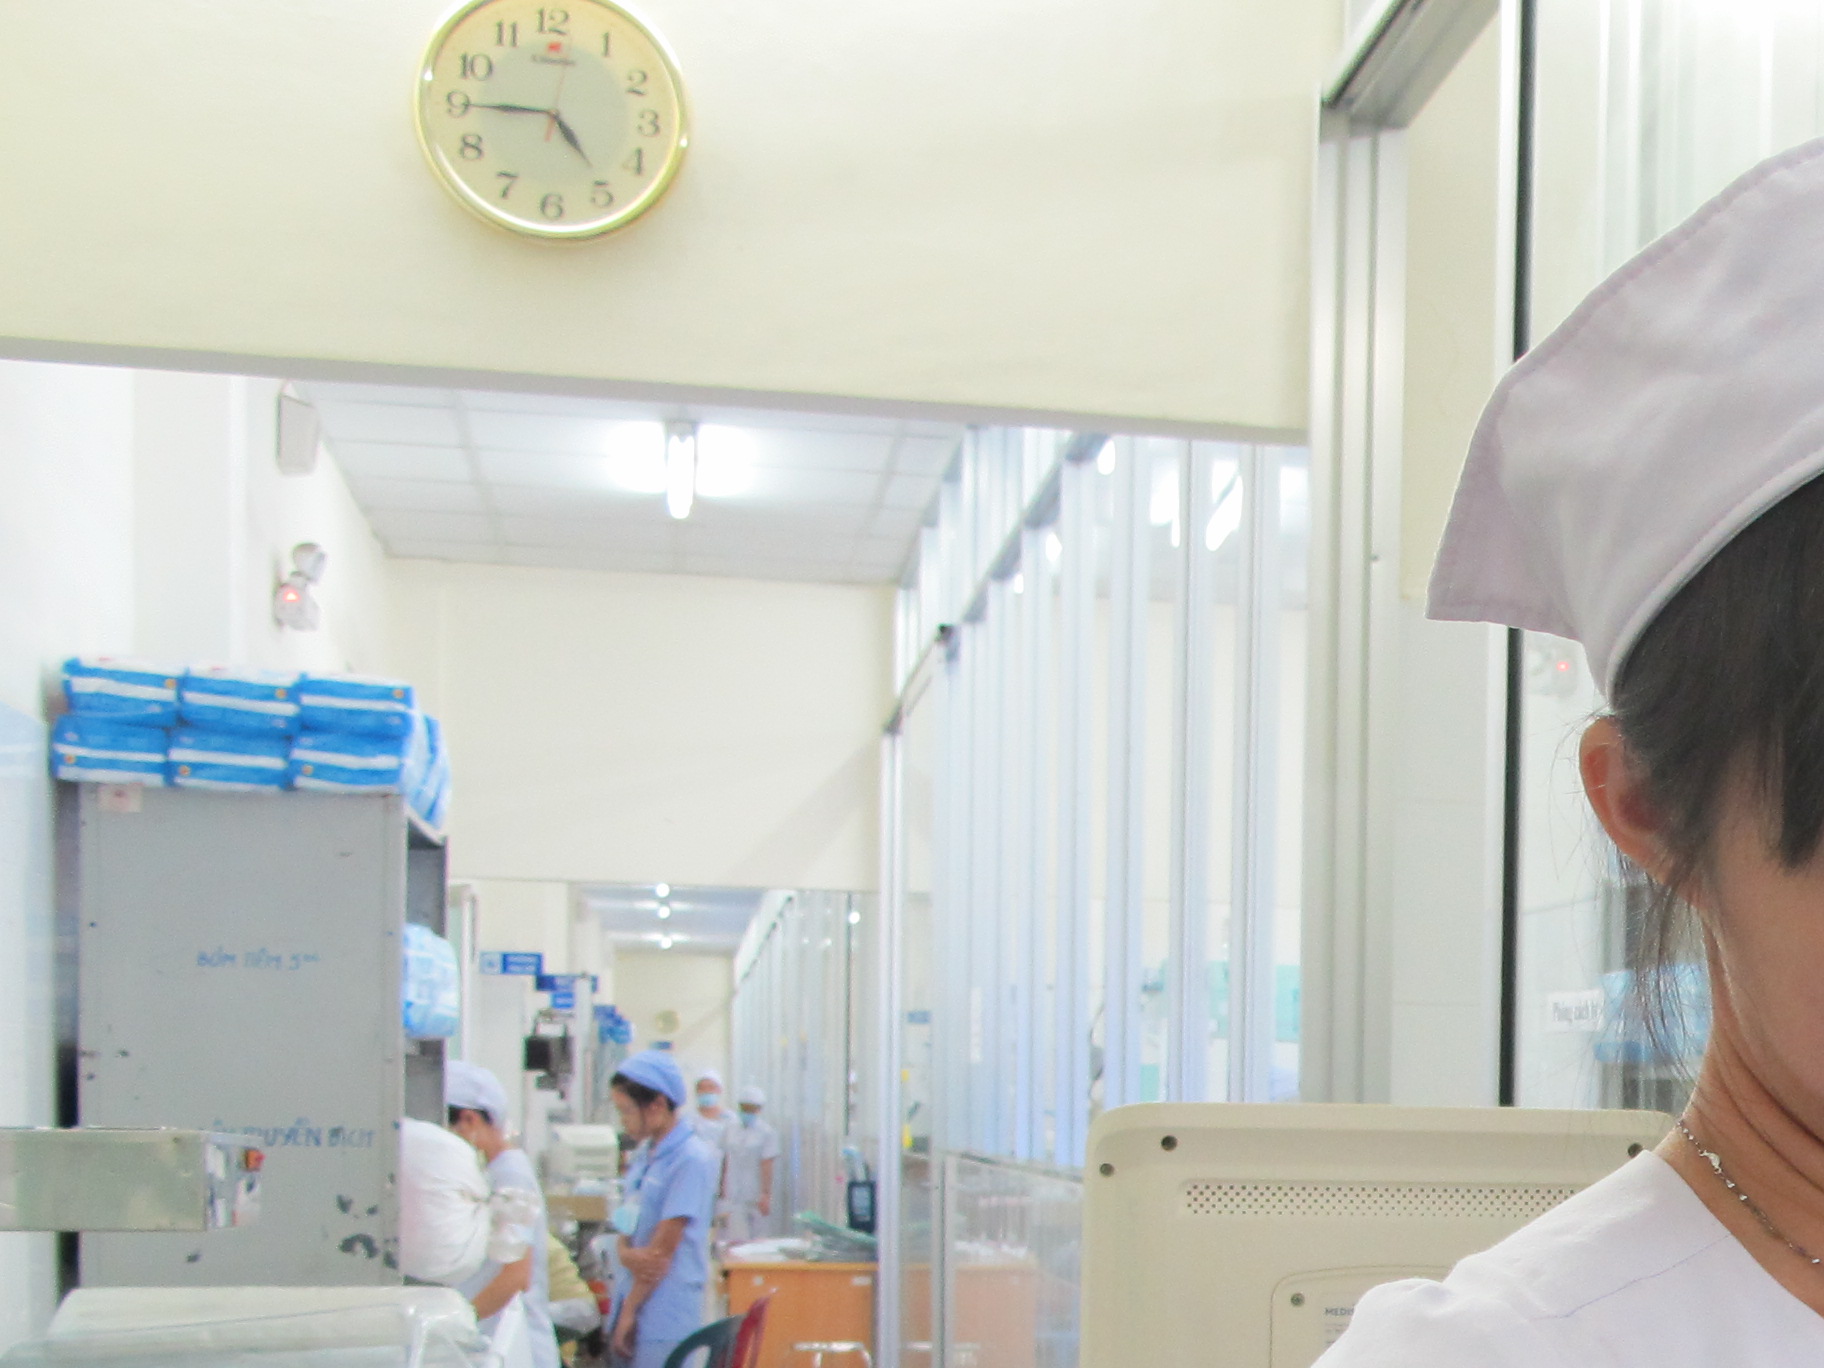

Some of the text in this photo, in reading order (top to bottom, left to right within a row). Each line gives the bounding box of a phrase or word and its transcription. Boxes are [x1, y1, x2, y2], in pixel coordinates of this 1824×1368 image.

[495, 21, 518, 48] 11
[536, 8, 569, 35] 12
[601, 31, 611, 58] 1
[459, 53, 493, 81] 10
[627, 70, 648, 96] 2
[446, 90, 470, 117] 9
[637, 109, 660, 138] 3
[459, 133, 483, 161] 8
[623, 147, 644, 176] 4
[496, 171, 519, 199] 7
[590, 180, 614, 208] 5
[539, 193, 564, 220] 6
